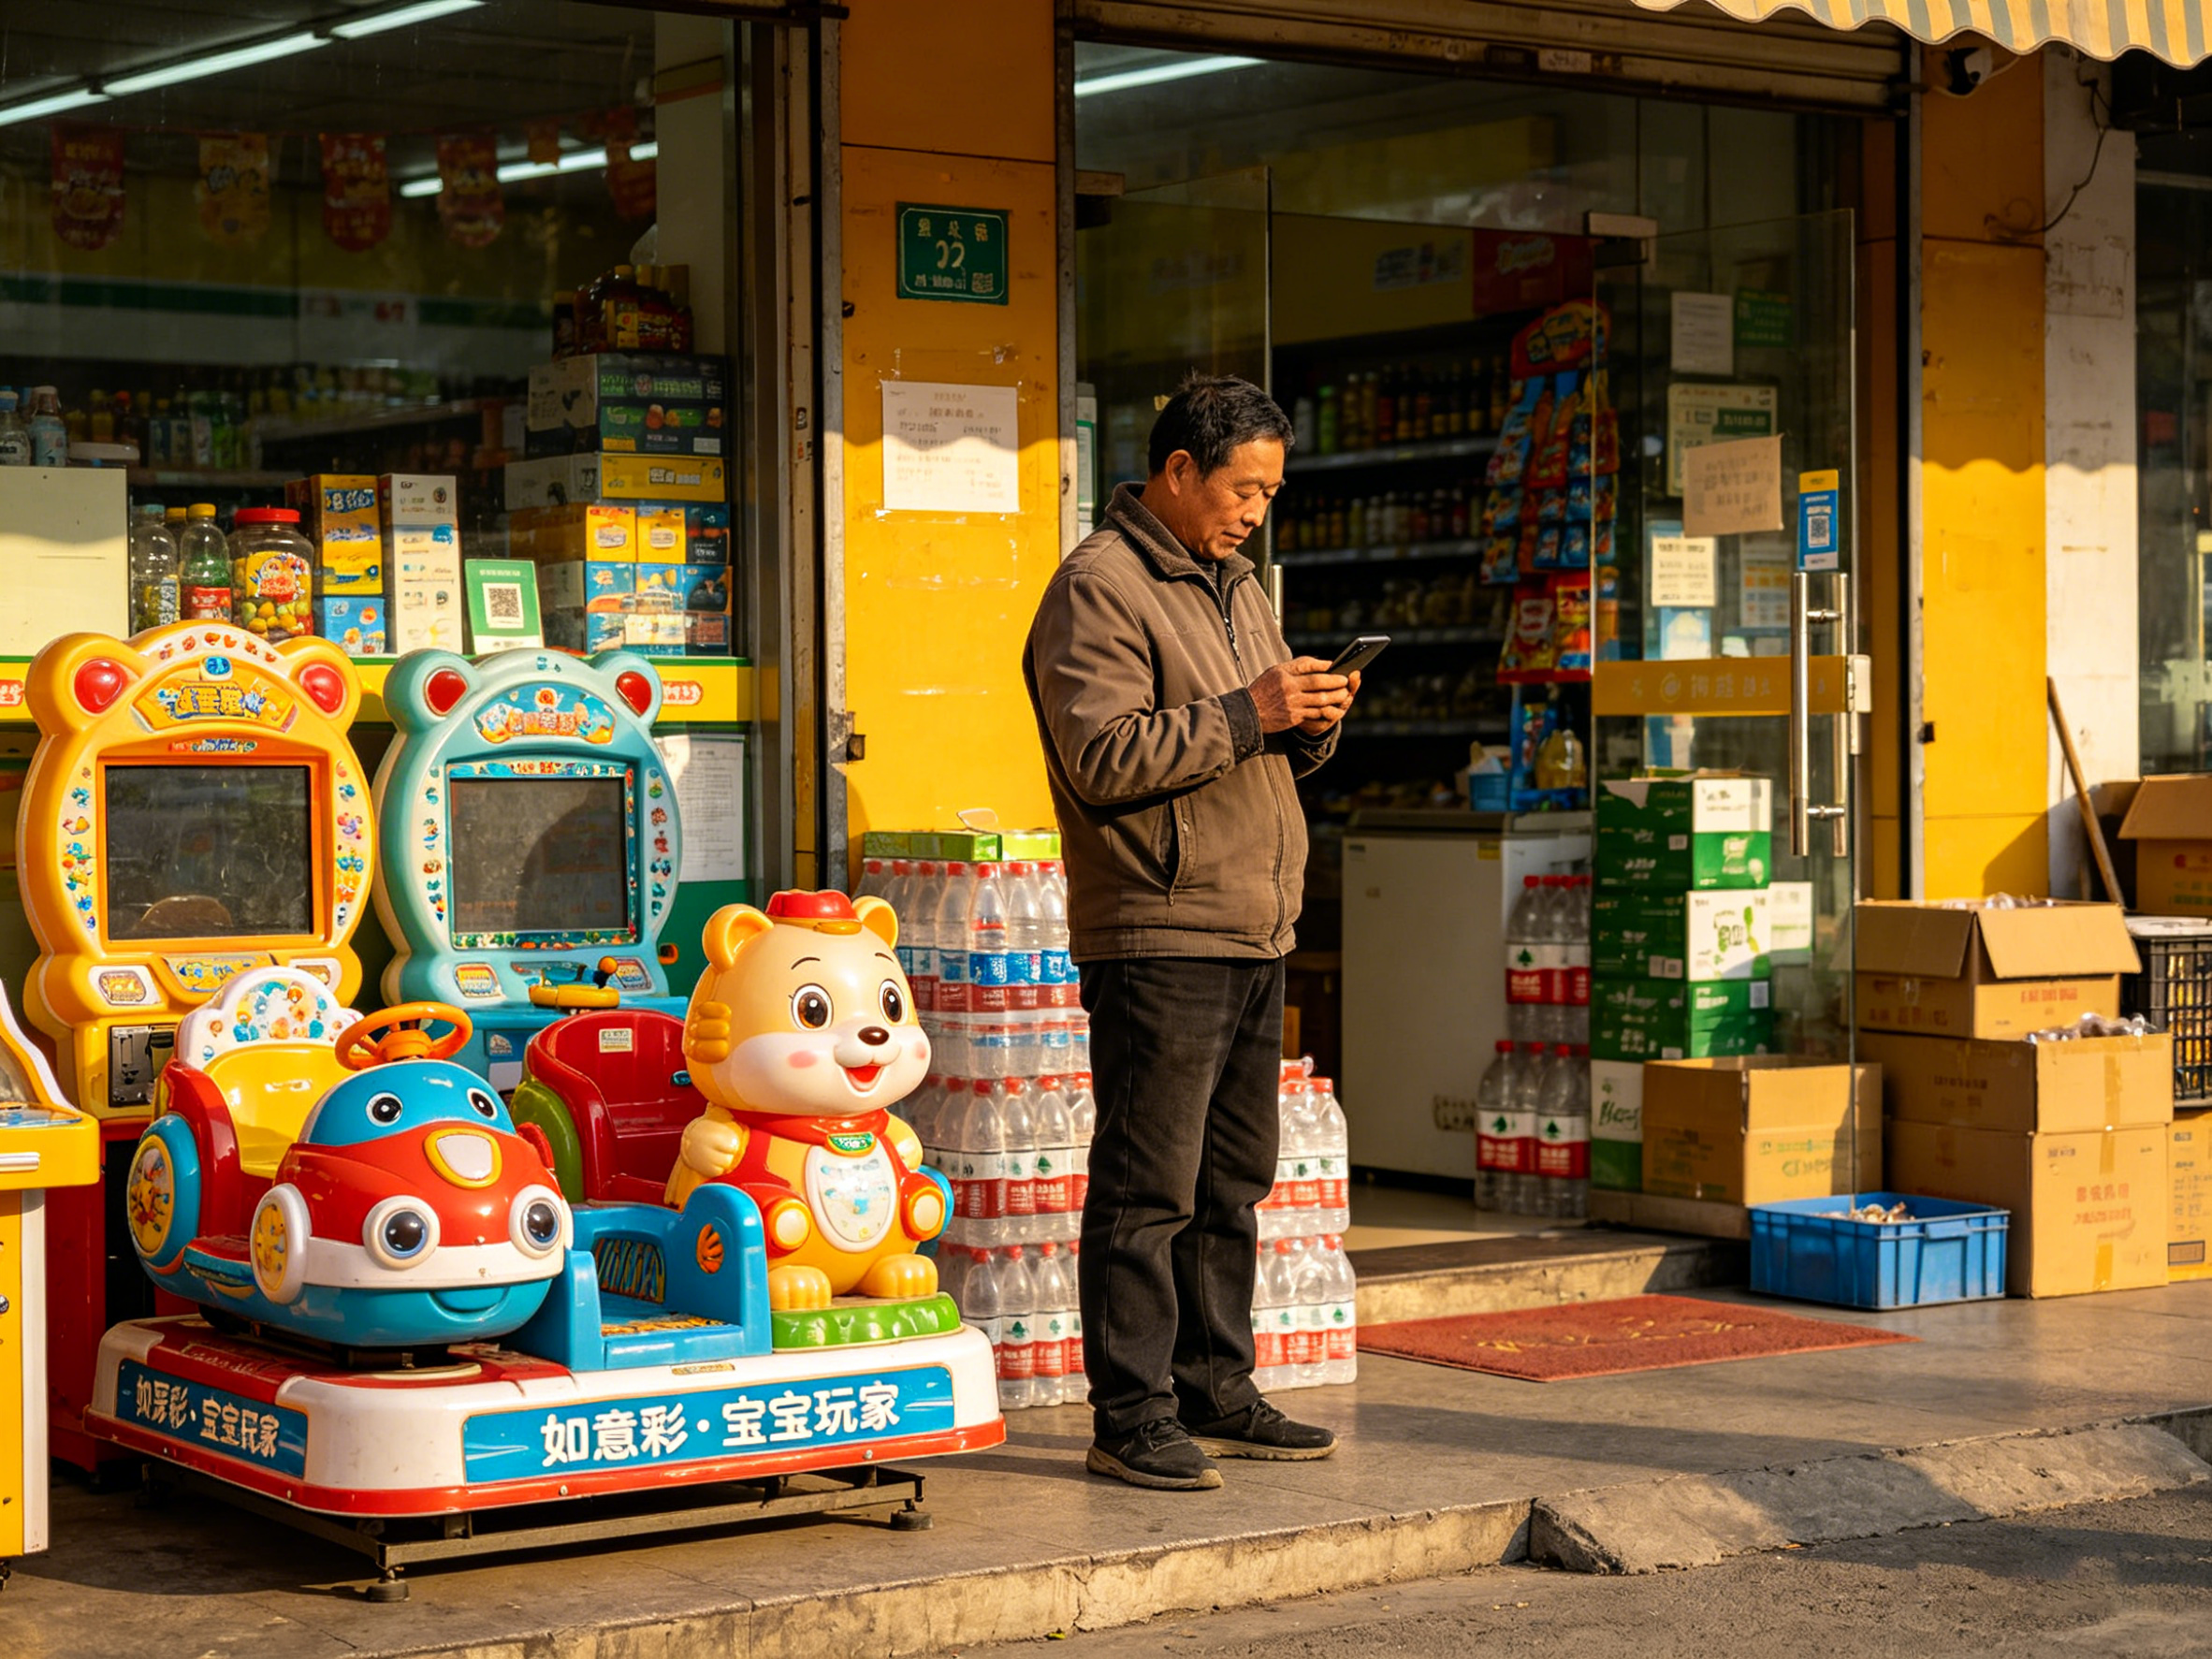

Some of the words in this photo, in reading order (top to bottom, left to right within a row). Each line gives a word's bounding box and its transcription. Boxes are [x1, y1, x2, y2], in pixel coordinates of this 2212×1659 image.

[541, 1381, 900, 1467] 如意彩·宝宝玩家
